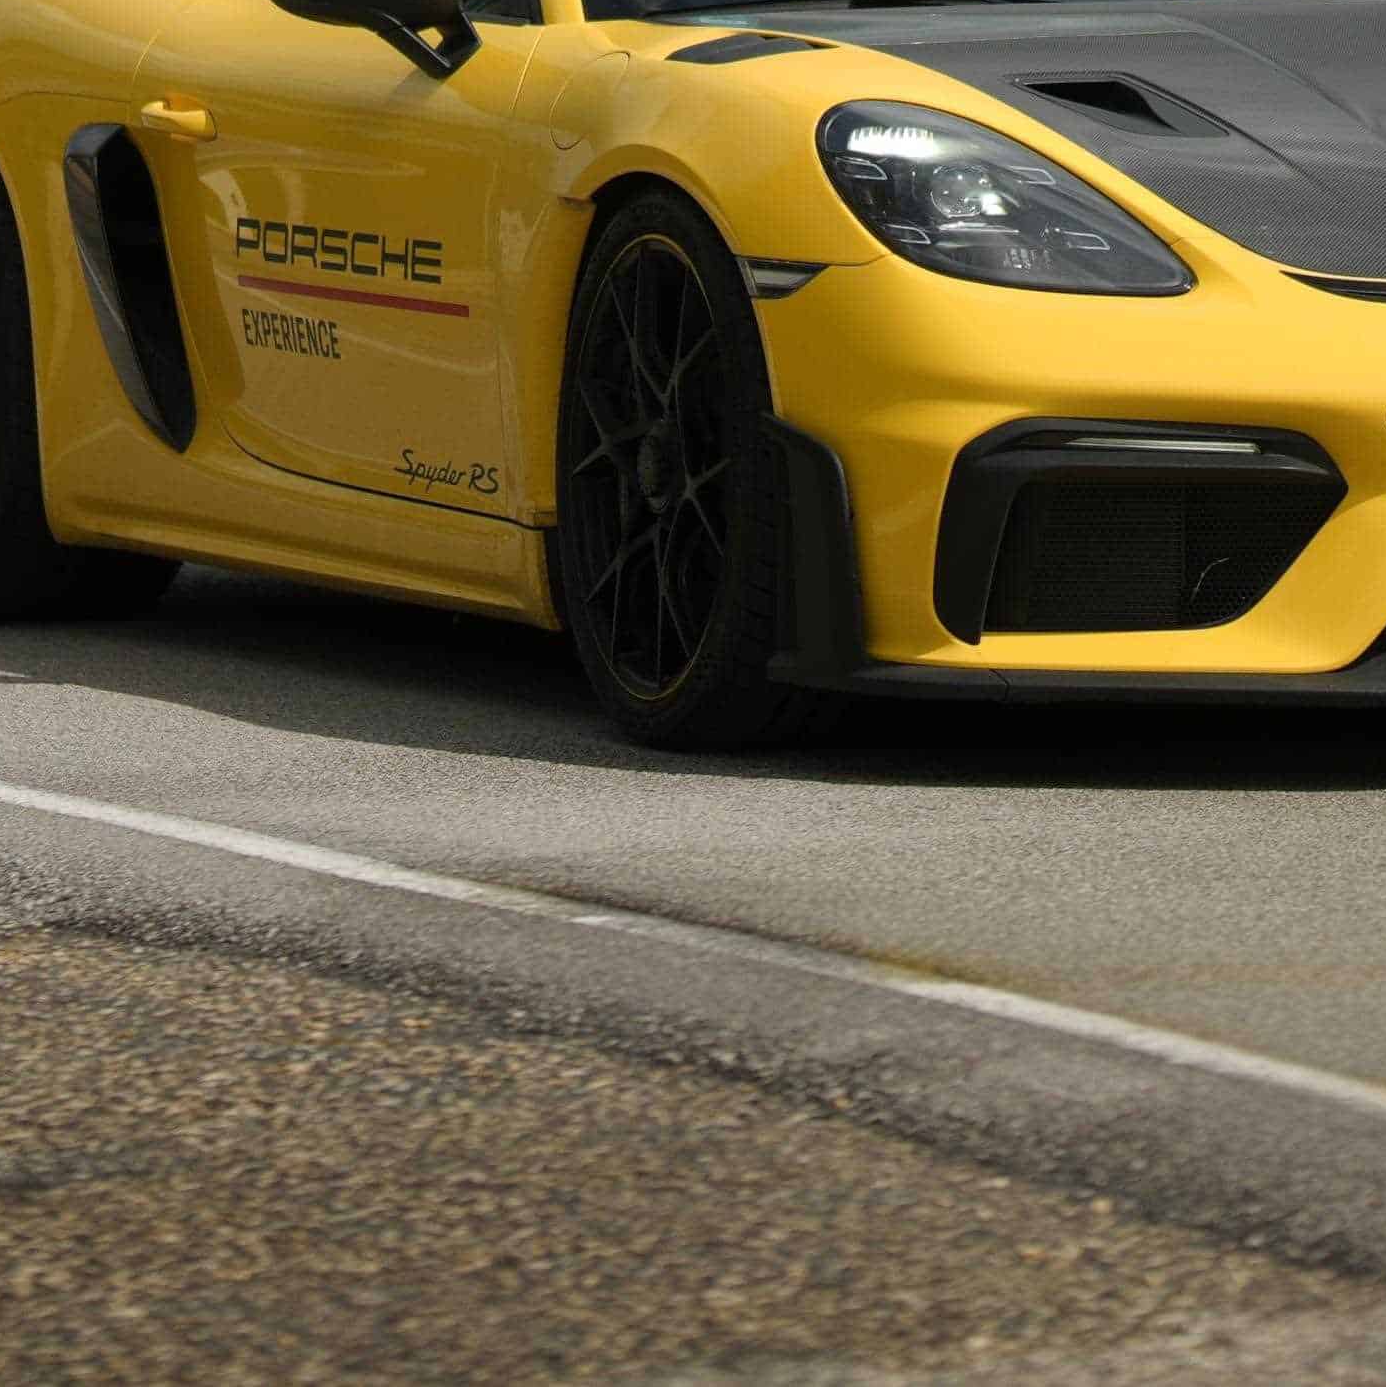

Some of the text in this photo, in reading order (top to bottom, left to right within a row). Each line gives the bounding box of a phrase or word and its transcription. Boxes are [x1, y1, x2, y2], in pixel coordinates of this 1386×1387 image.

[236, 217, 443, 285] PORSCHE
[241, 308, 342, 360] EXPERIENCE
[393, 449, 500, 494] Spyder RS
